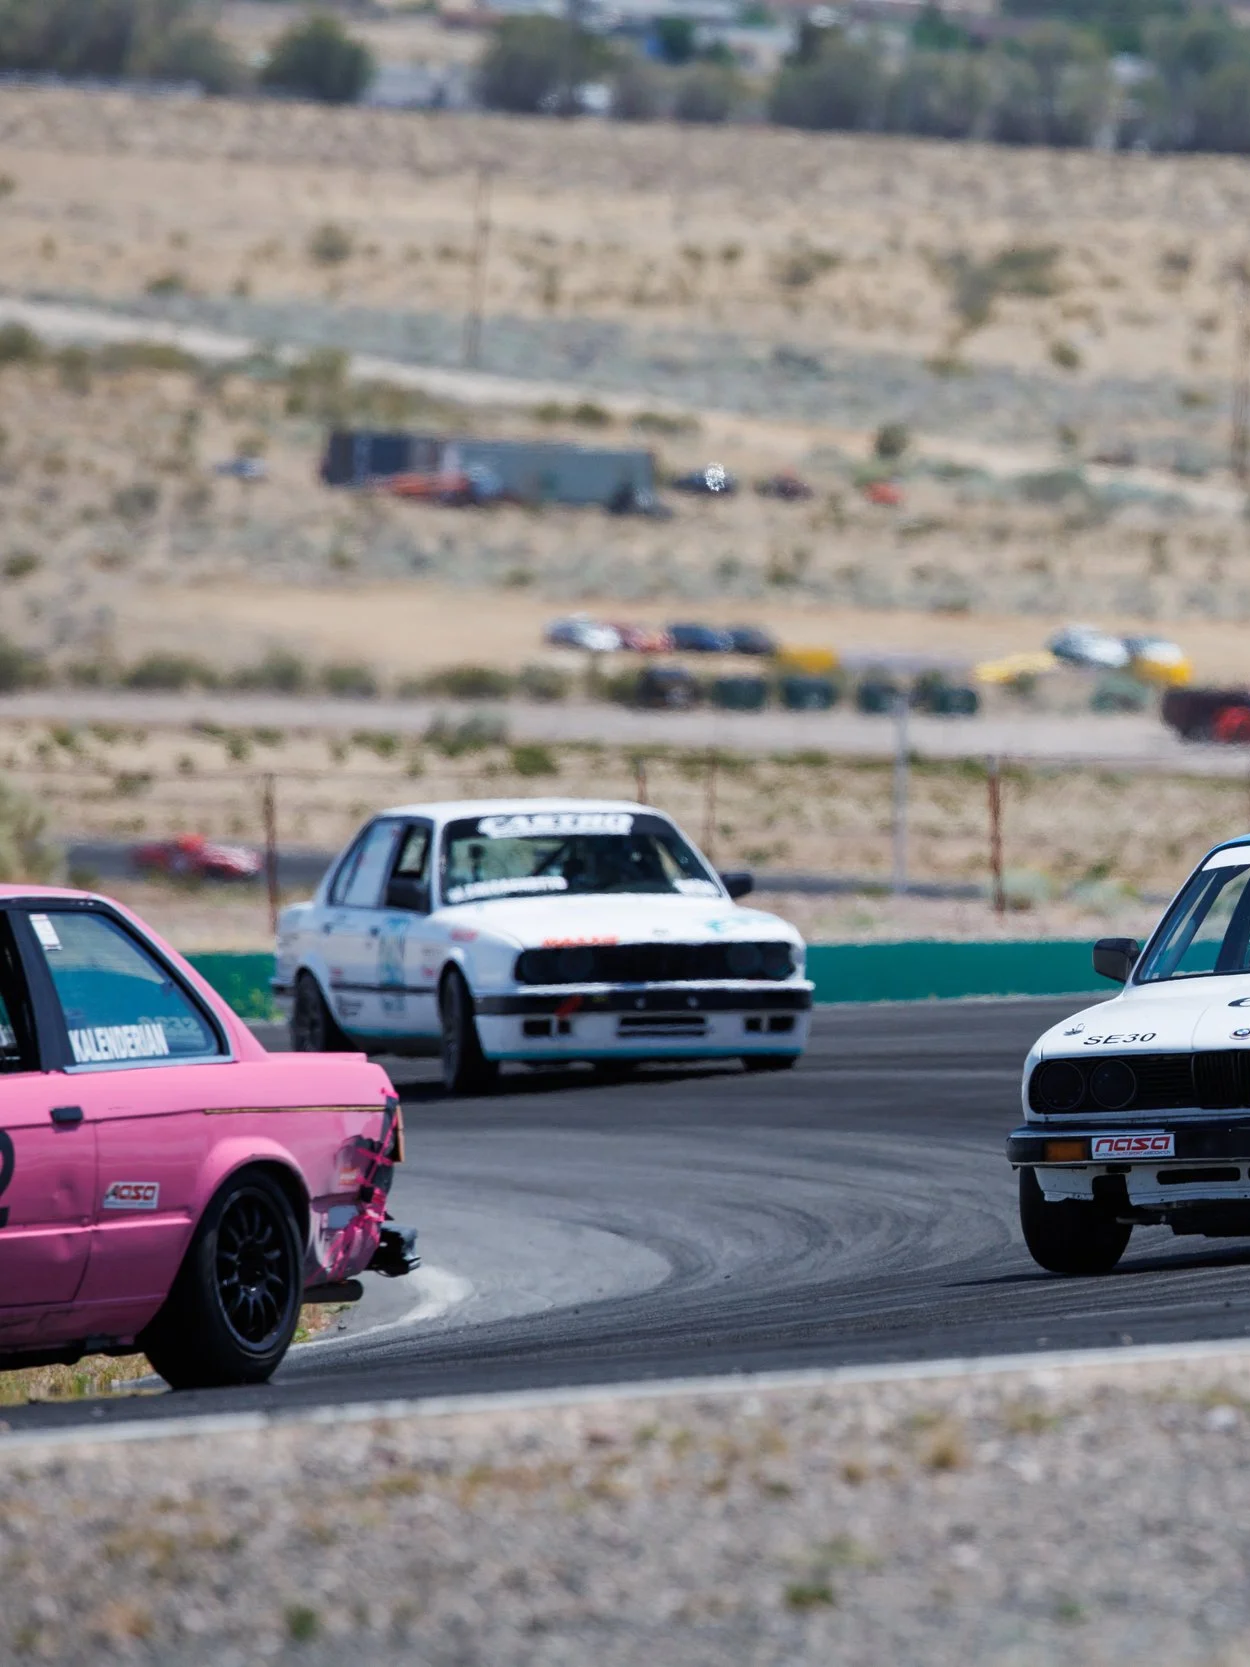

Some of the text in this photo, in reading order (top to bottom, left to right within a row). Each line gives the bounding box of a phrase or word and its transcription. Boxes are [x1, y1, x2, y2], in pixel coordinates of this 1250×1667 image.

[68, 1023, 170, 1063] KALENDERIAN
[1083, 1032, 1157, 1046] SE30
[1095, 1136, 1170, 1152] nasa
